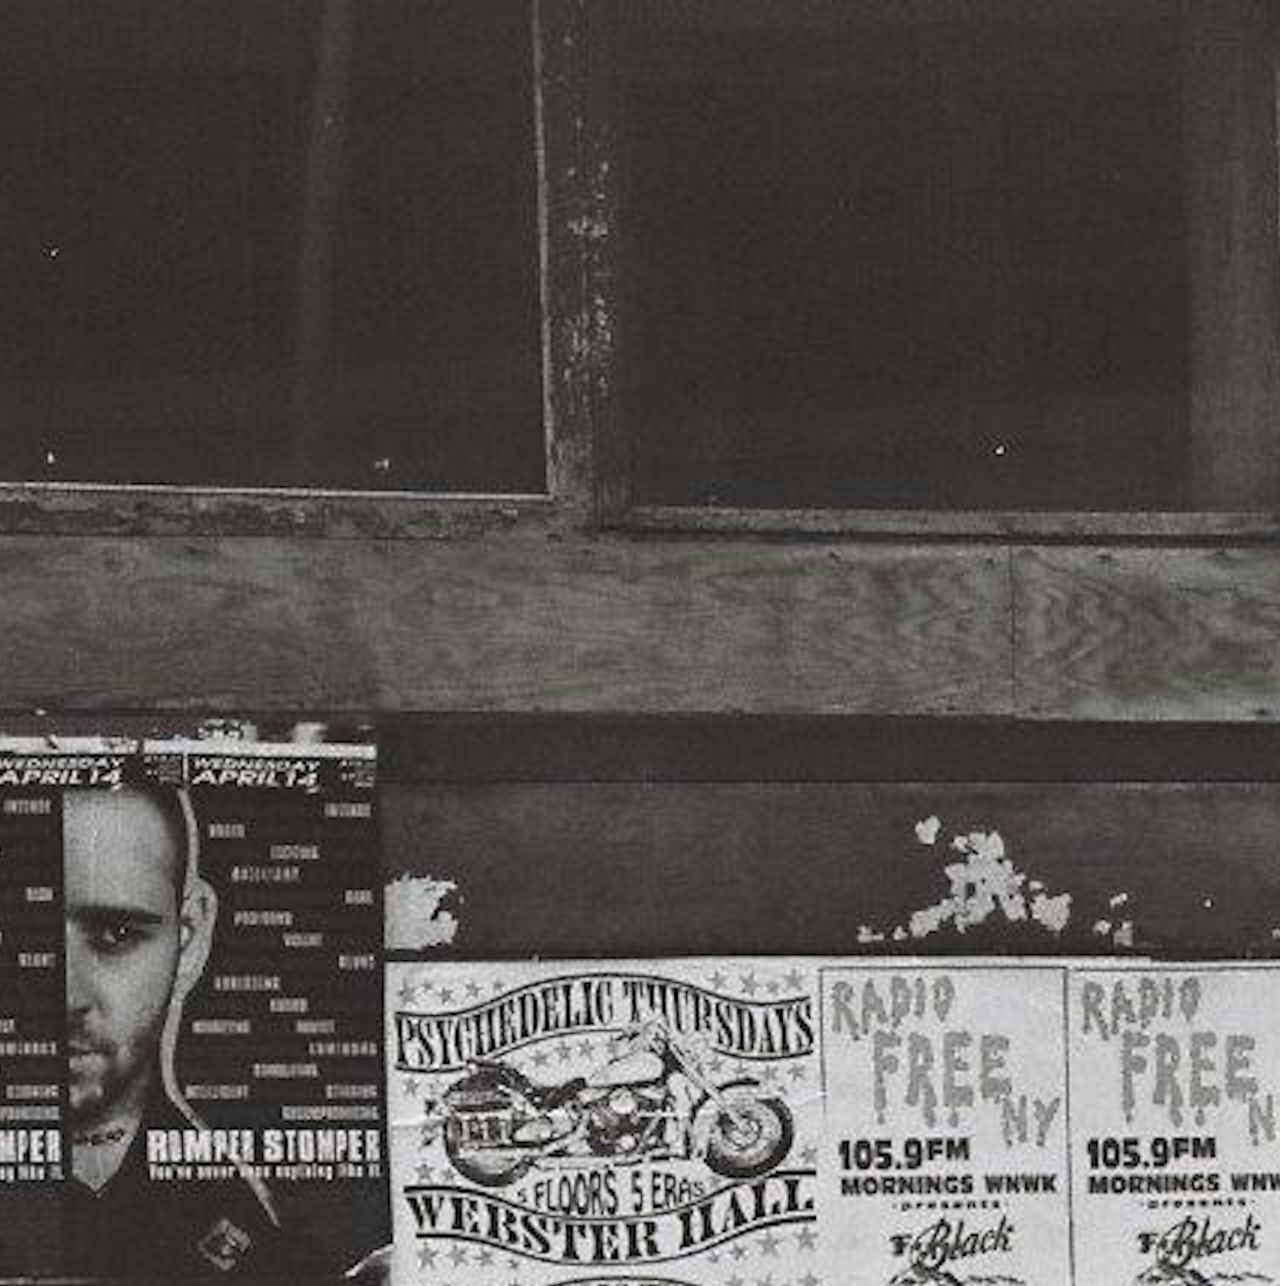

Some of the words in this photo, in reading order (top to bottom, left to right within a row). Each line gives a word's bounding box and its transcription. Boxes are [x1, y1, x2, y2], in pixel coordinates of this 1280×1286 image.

[92, 768, 123, 790] 14
[192, 770, 279, 787] APRIL
[286, 771, 320, 793] 14
[193, 757, 321, 772] WEDNESDAY
[393, 981, 615, 1069] PSYCHEDELIC
[622, 981, 815, 1057] THURSDAYS
[831, 975, 956, 1041] RADIO
[1081, 976, 1201, 1041] RADIO
[872, 1030, 1013, 1128] FREE
[1122, 1030, 1259, 1128] FREE
[146, 1129, 255, 1163] ROMPER
[263, 1129, 381, 1163] STOMPER
[1000, 1096, 1061, 1148] NY
[534, 1170, 618, 1215] FLOORS
[631, 1170, 644, 1213] 5
[840, 1176, 974, 1197] MORNINGS
[984, 1174, 1058, 1195] WNWK
[1087, 1174, 1220, 1196] MORNINGS
[407, 1196, 661, 1261] WEBSTER
[679, 1180, 814, 1250] HALL
